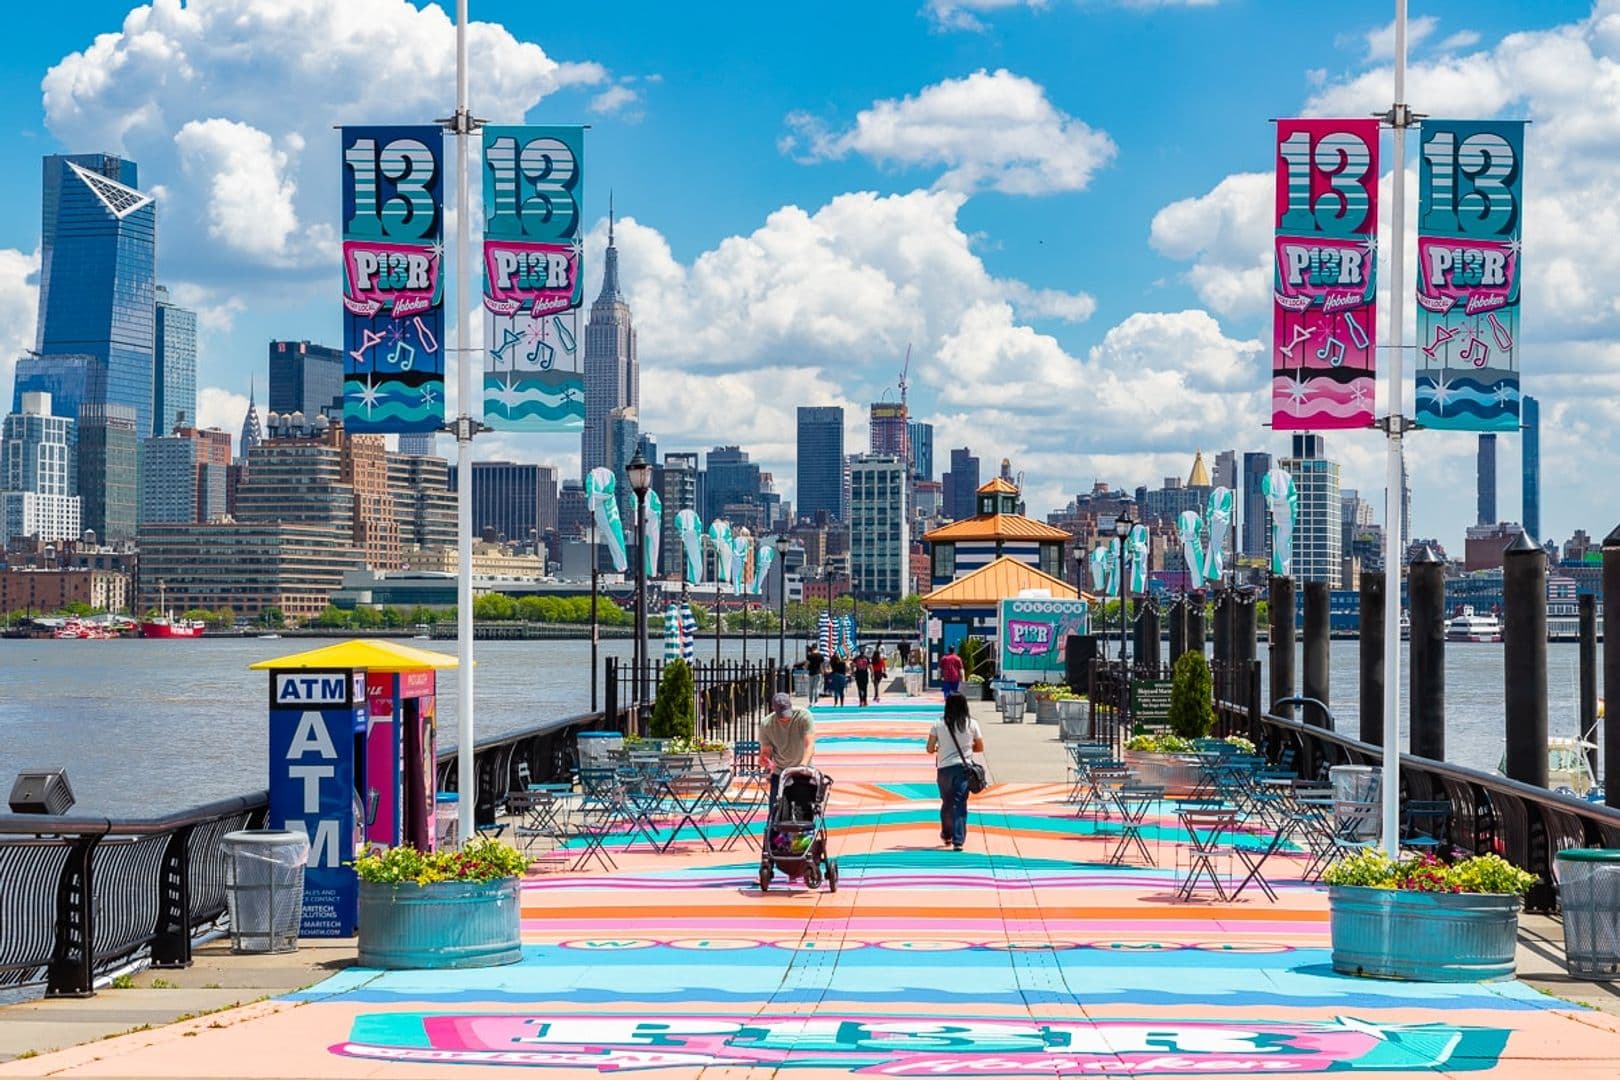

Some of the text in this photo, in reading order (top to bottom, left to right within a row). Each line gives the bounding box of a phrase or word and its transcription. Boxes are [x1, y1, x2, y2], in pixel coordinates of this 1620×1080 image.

[345, 138, 436, 238] 13
[485, 137, 577, 238] 13
[1279, 131, 1371, 232] 13
[1423, 131, 1515, 233] 13
[353, 250, 430, 289] P13R
[494, 249, 570, 289] P13R
[1286, 245, 1362, 285] P13R
[1428, 246, 1506, 286] P13R
[392, 296, 429, 317] Hoboken
[532, 296, 568, 317] Hoboken
[1323, 292, 1361, 313] Hoboken
[1466, 293, 1505, 314] Hoboken
[1013, 602, 1083, 613] WELCOME
[1012, 623, 1048, 642] P13R
[280, 678, 344, 700] ATM
[284, 711, 341, 868] ATM
[892, 1054, 1306, 1074] Hoboken
